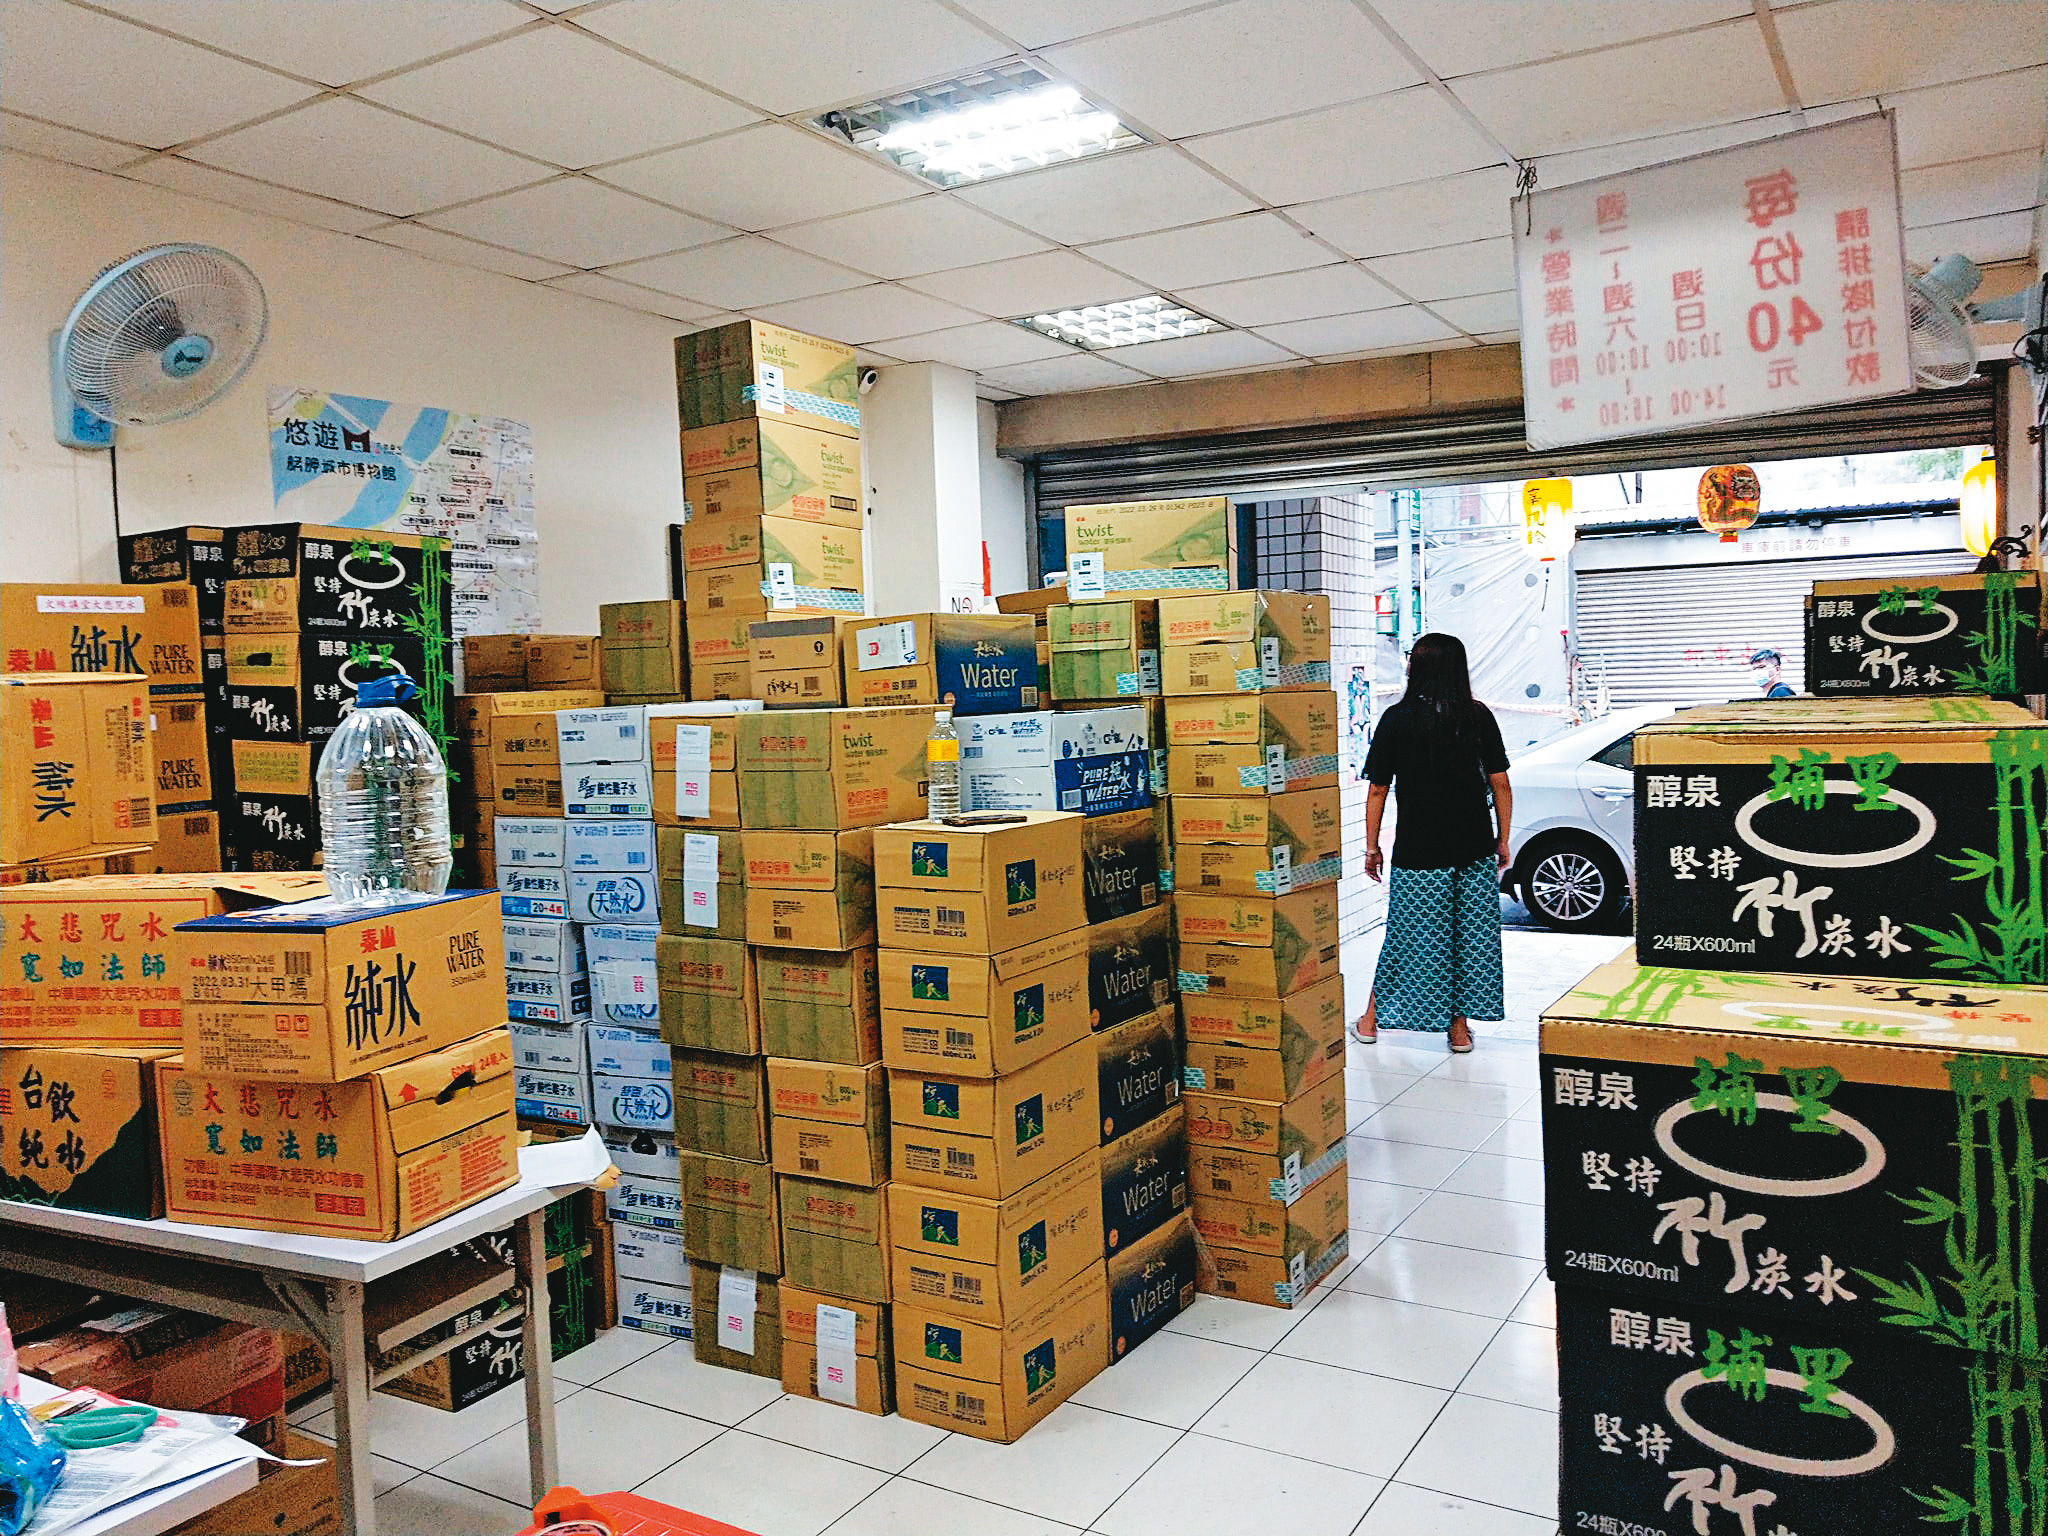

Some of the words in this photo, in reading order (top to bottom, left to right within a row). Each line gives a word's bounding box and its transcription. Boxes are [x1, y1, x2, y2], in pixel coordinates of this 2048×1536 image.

[760, 342, 788, 359] twist
[284, 417, 340, 451] 悠遊
[820, 449, 846, 465] twist
[1077, 523, 1114, 538] twist
[193, 545, 224, 562] 醇泉
[305, 542, 334, 560] 醇泉
[822, 541, 846, 556] twist
[314, 576, 342, 593] 堅持
[1818, 601, 1856, 618] 醇泉
[153, 644, 188, 661] PURE
[318, 640, 350, 657] 醇泉
[1828, 634, 1865, 653] 堅持
[150, 659, 194, 675] WATER
[960, 663, 1019, 689] Water
[1859, 645, 1945, 689] 竹炭水
[314, 683, 342, 700] 堅持
[843, 733, 874, 749] twist
[162, 758, 195, 776] PURE
[1083, 767, 1109, 784] PURE
[1767, 748, 1900, 812] 埔里
[157, 774, 202, 791] WATER
[1086, 783, 1120, 802] WATER
[1646, 773, 1722, 808] 醇泉
[1669, 845, 1742, 882] 堅持
[1087, 865, 1139, 897] Water
[20, 912, 168, 943] 大悲咒水
[1733, 870, 1912, 958] 竹炭水
[360, 925, 397, 954] 泰山
[449, 930, 480, 954] PURE
[1653, 934, 1756, 955] 24瓶X600ml
[446, 948, 486, 974] WATER
[1104, 964, 1151, 1000] Water
[344, 953, 421, 1050] 純水
[1117, 1066, 1163, 1106] Water
[1554, 1067, 1638, 1111] 醇泉
[1690, 1051, 1844, 1136] 埔里
[202, 1083, 339, 1122] 大悲咒水
[1581, 1150, 1663, 1198] 堅持
[1123, 1170, 1170, 1216] Water
[1653, 1192, 1858, 1305] 竹炭水
[1565, 1249, 1679, 1283] 24瓶X600ml
[1131, 1272, 1178, 1323] Water
[1610, 1307, 1695, 1358] 醇泉
[1701, 1327, 1854, 1419] 埔里
[1594, 1413, 1672, 1465] 堅持
